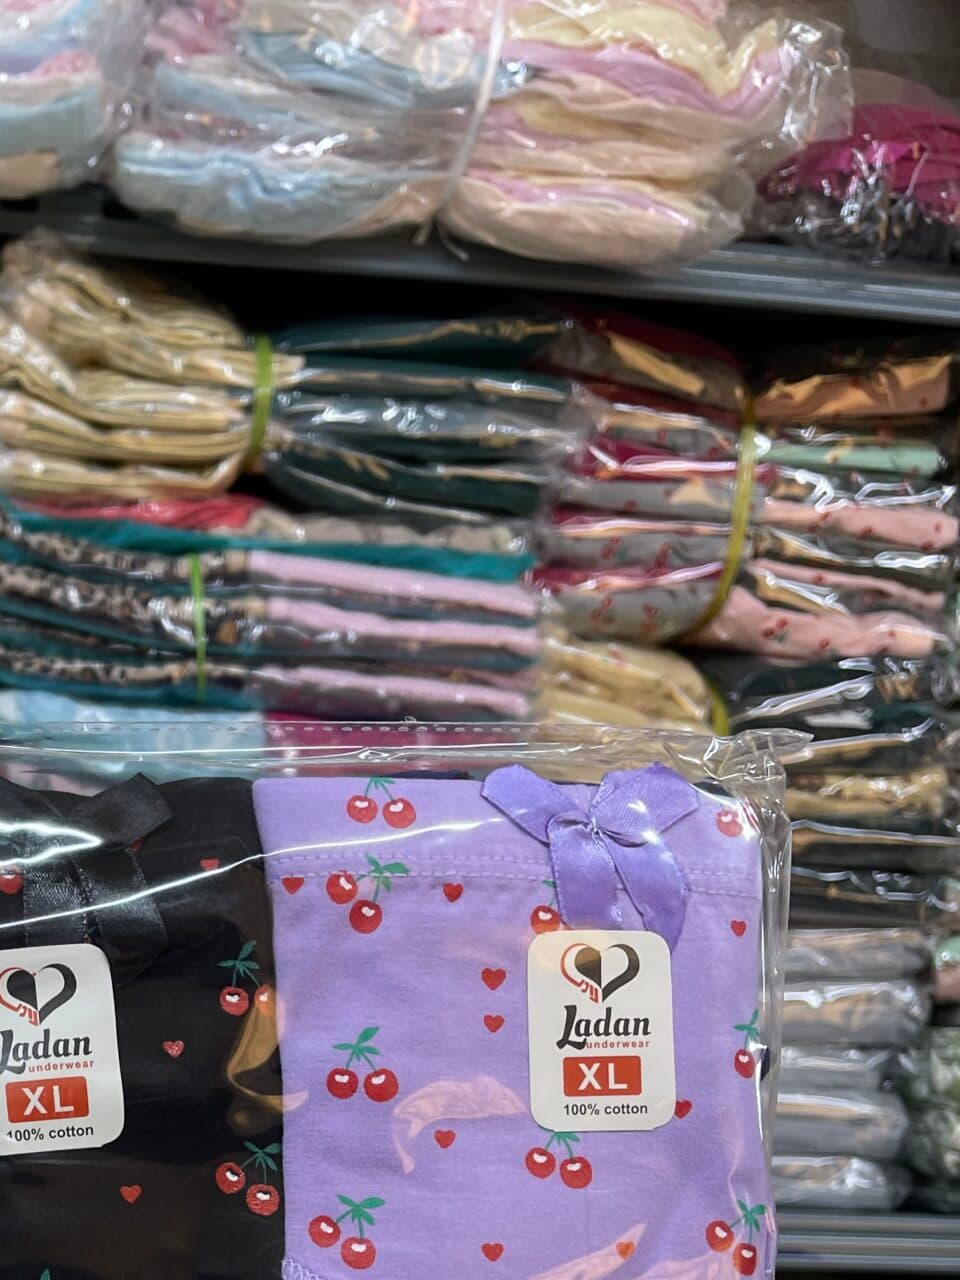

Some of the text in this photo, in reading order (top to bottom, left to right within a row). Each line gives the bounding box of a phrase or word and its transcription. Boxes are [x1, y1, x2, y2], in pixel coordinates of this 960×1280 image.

[556, 1004, 651, 1050] Ladan
[586, 1040, 650, 1049] underwear
[28, 1060, 95, 1073] underwear
[578, 1062, 628, 1091] XL
[22, 1084, 75, 1116] XL
[563, 1103, 648, 1115] 100% cotton
[48, 1125, 94, 1139] cotton
